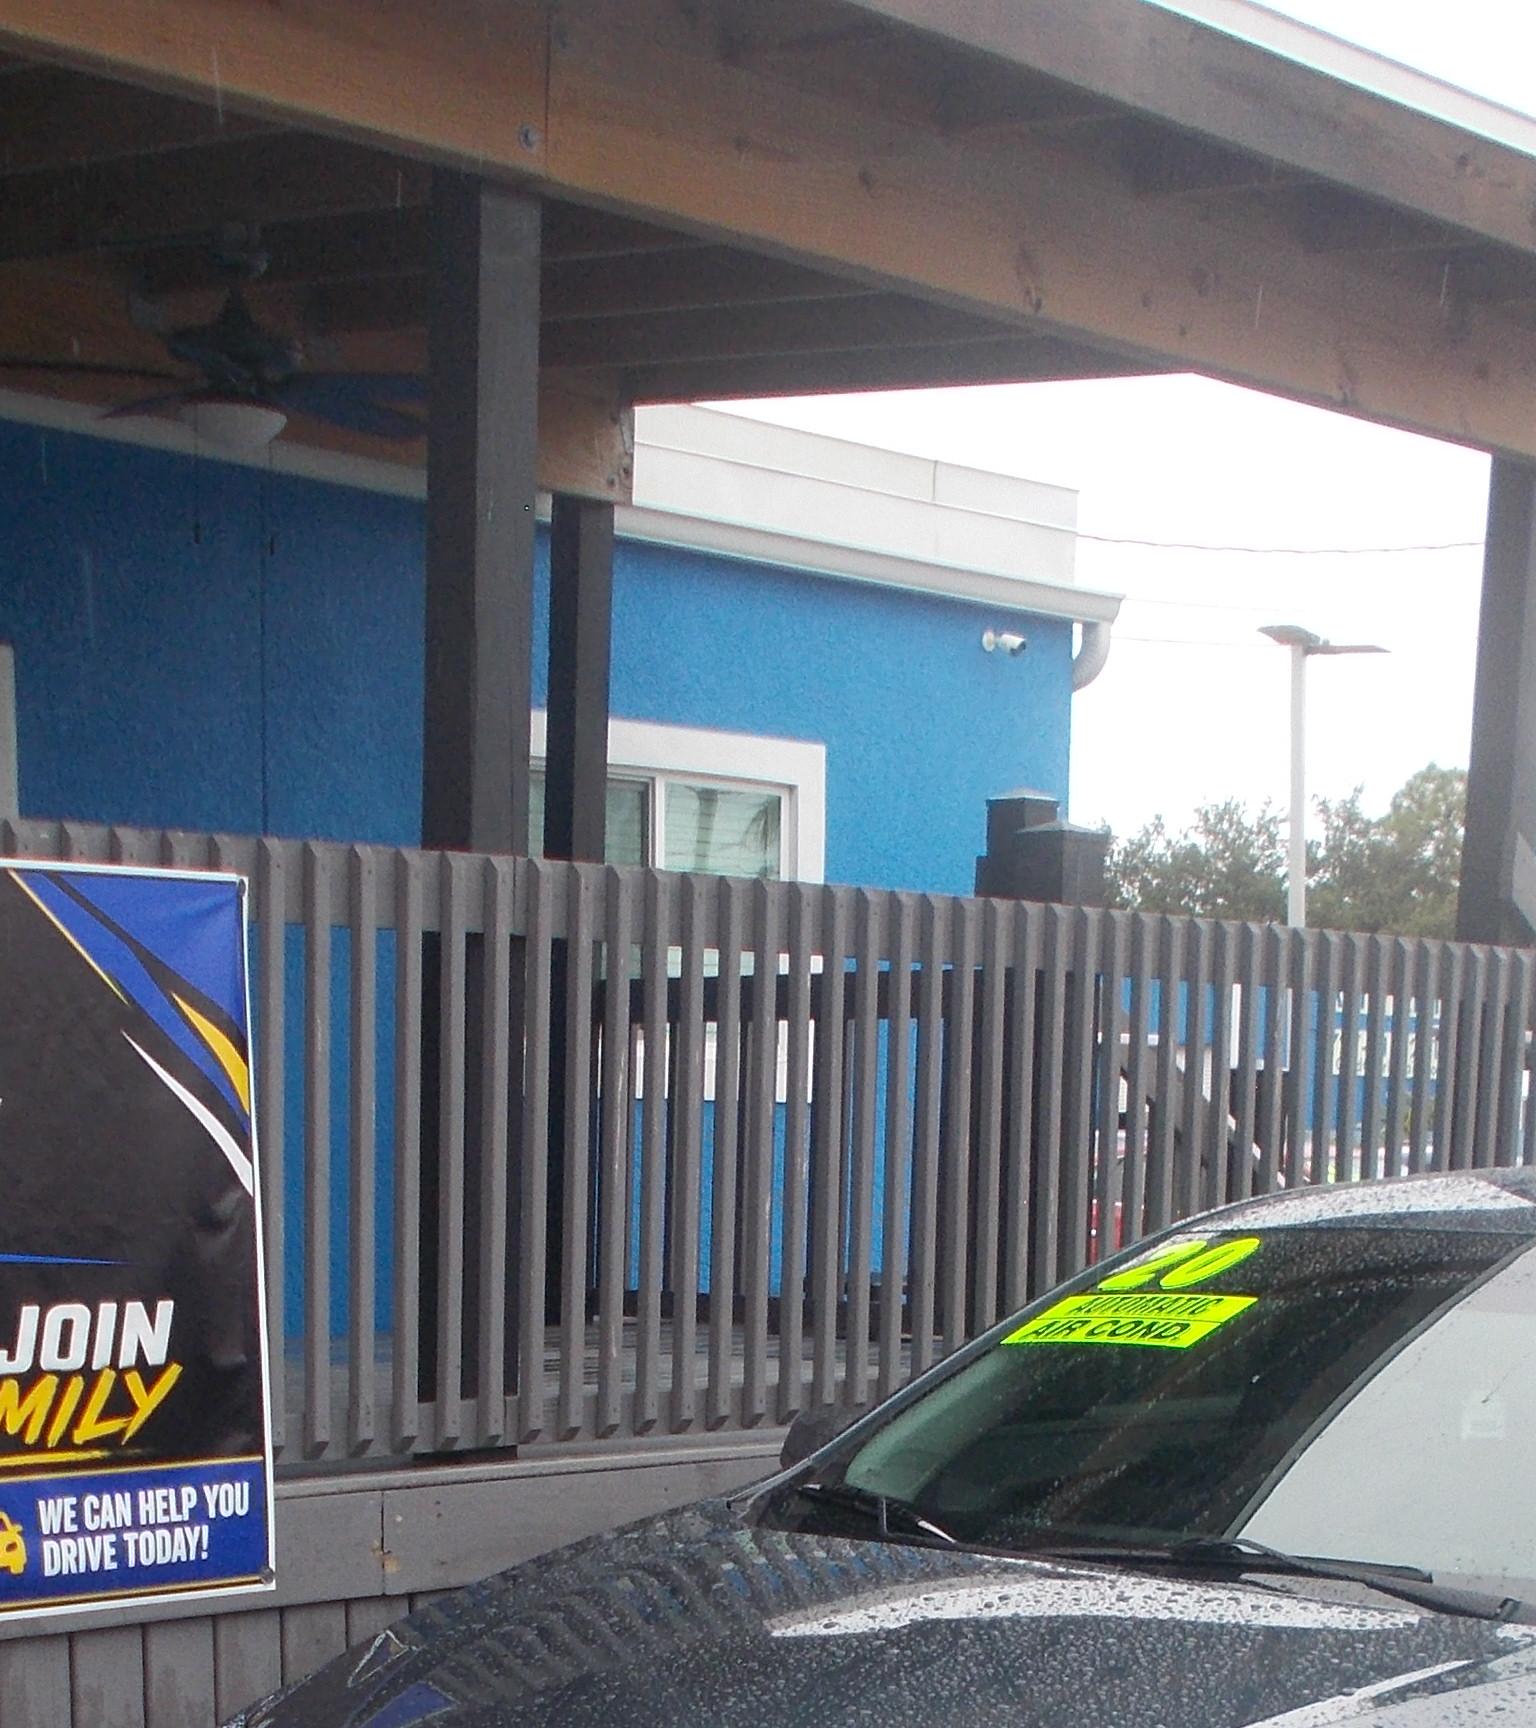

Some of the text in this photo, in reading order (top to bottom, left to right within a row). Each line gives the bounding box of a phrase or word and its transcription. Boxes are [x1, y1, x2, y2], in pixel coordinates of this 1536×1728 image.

[1096, 1237, 1261, 1291] 20
[1030, 1320, 1092, 1340] AIR
[38, 1481, 250, 1535] WE CAN HELP YOU
[42, 1524, 210, 1577] DRIVE TODAY!
